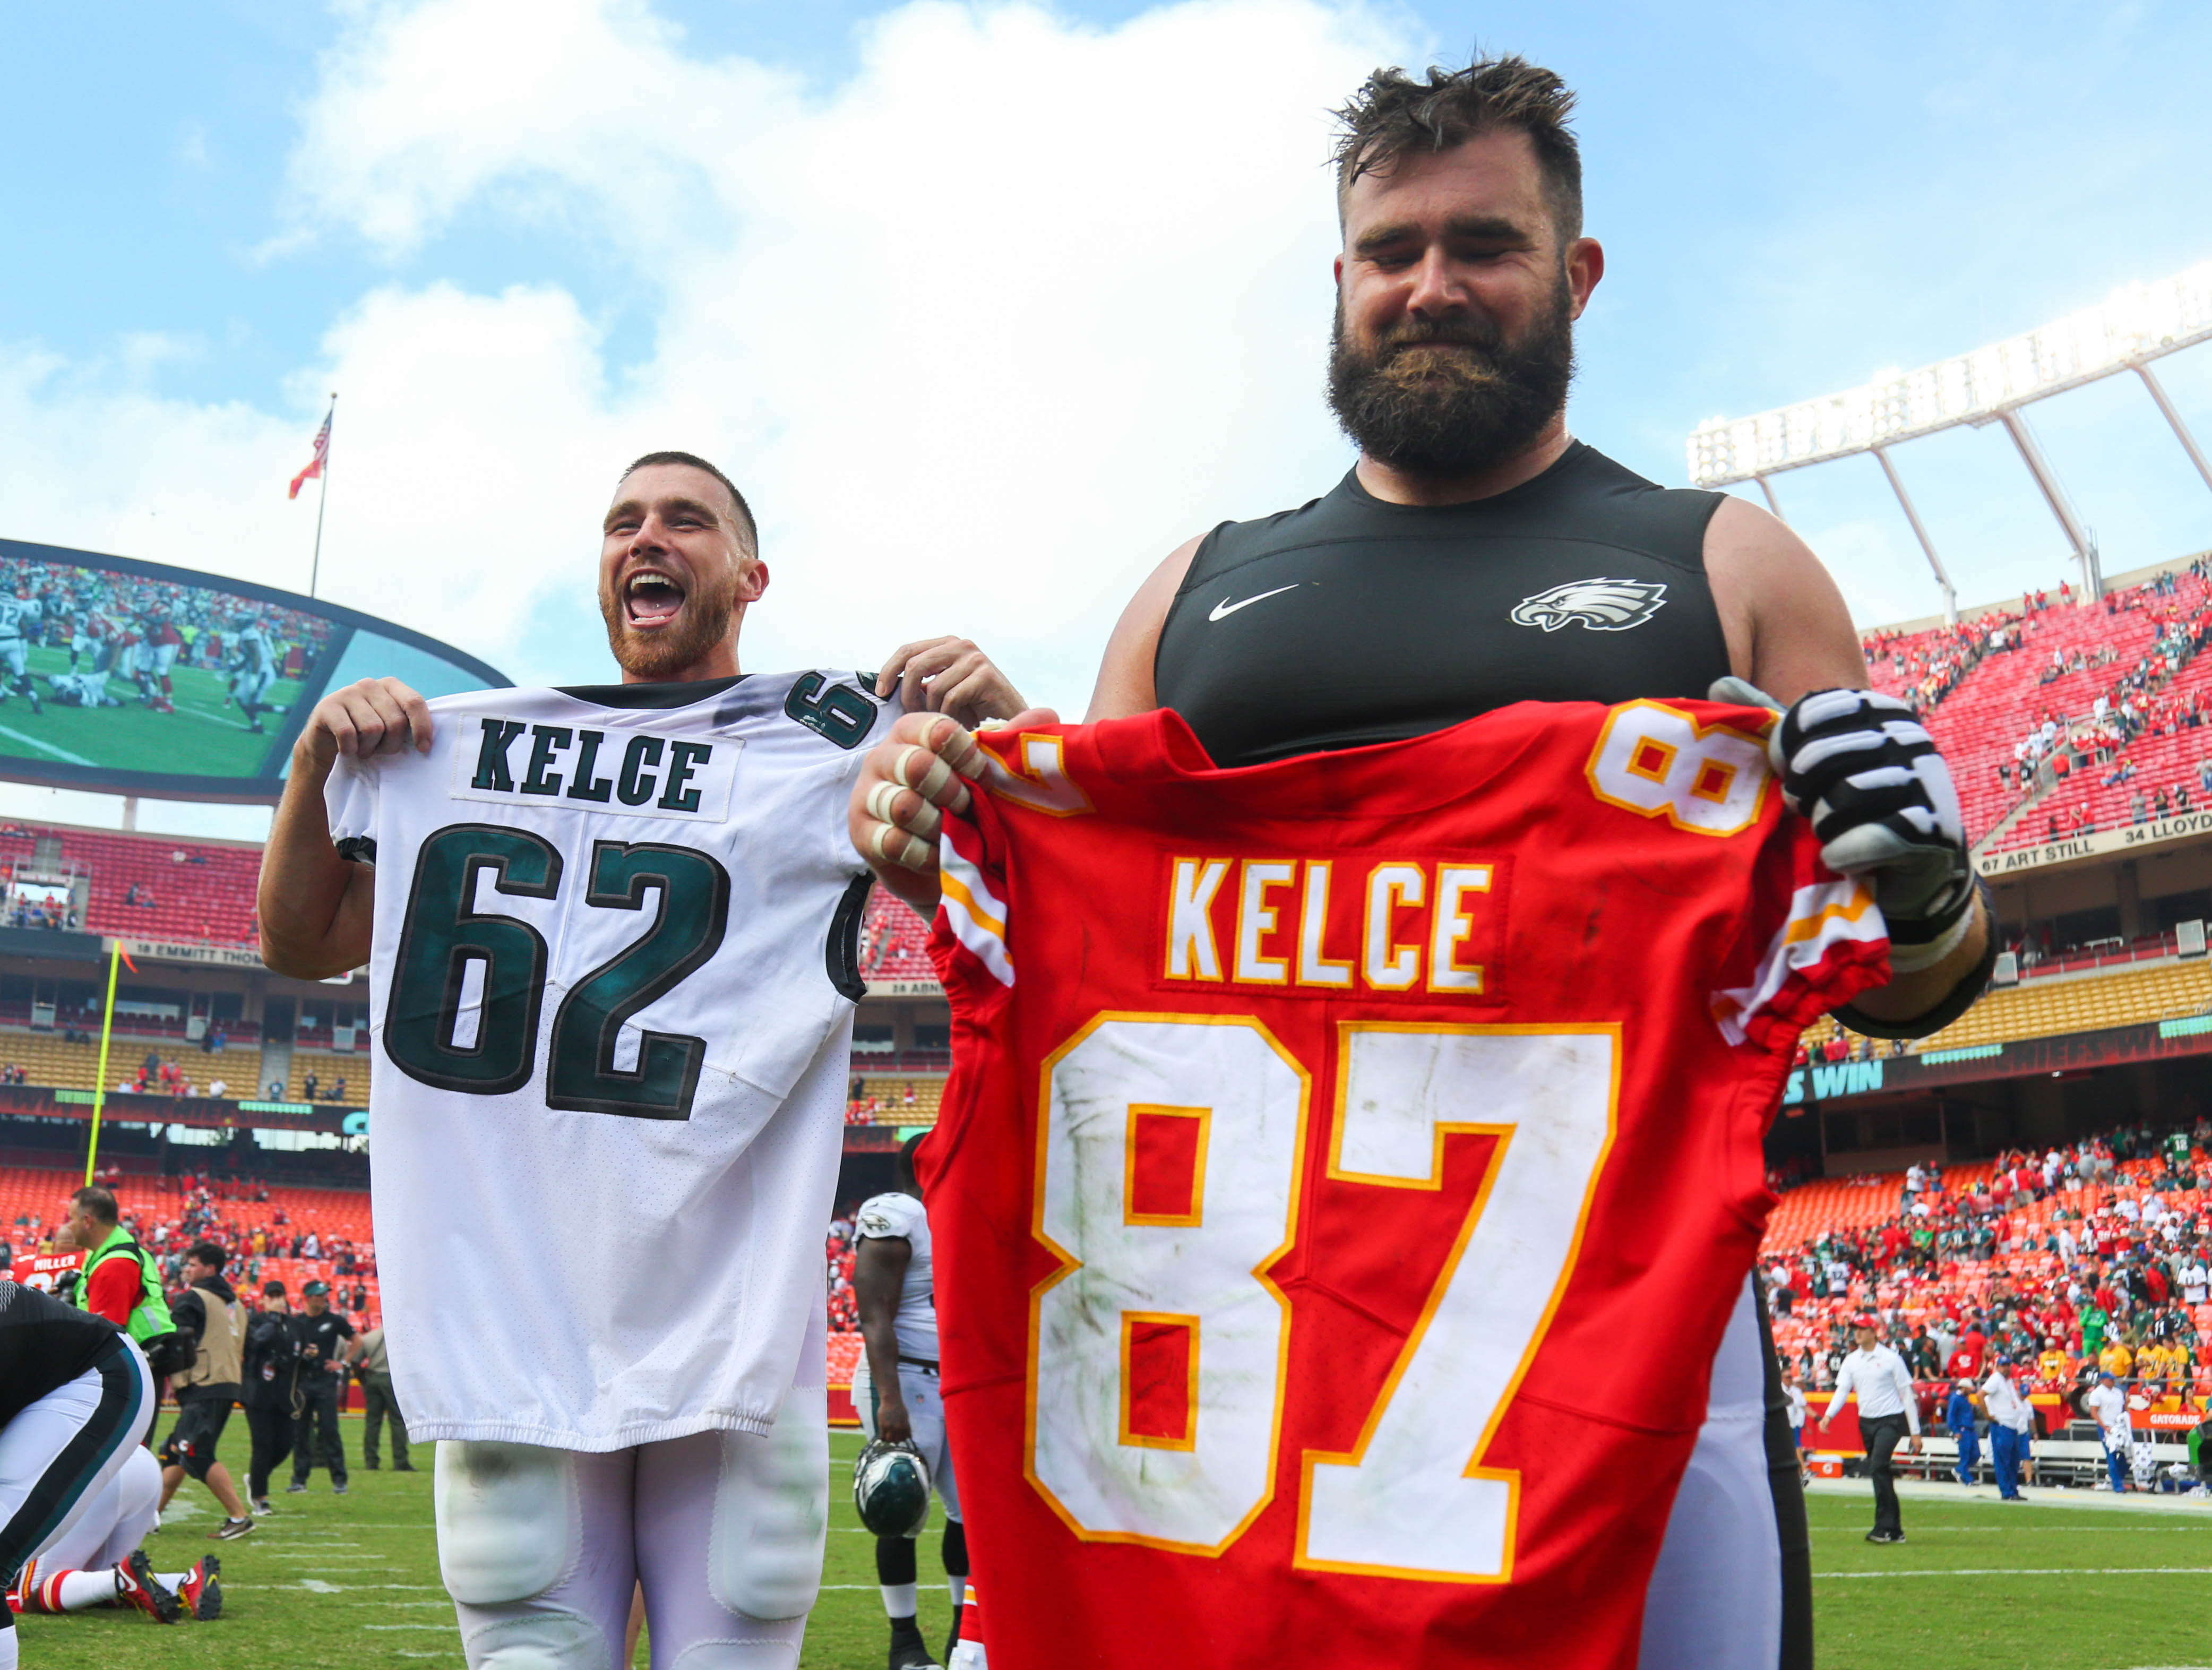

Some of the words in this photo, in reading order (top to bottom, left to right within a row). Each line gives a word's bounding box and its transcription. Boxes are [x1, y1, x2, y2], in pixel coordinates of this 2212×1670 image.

[785, 670, 902, 749] 6
[471, 718, 712, 812] KELCE
[1584, 698, 1778, 837] 8
[1982, 859, 1999, 872] 67
[2006, 850, 2039, 868] ART
[2045, 839, 2094, 860] STILL
[2125, 829, 2145, 843] 34
[2152, 815, 2212, 838] LLOYD
[137, 944, 151, 953] 18
[157, 945, 216, 959] EMMITT
[1165, 855, 1493, 995] KELCE
[383, 823, 731, 1121] 62
[1812, 1060, 1883, 1100] WIN
[34, 1254, 76, 1271] MILLER
[1024, 1010, 1623, 1583] 87
[2150, 1414, 2200, 1425] GATORADE
